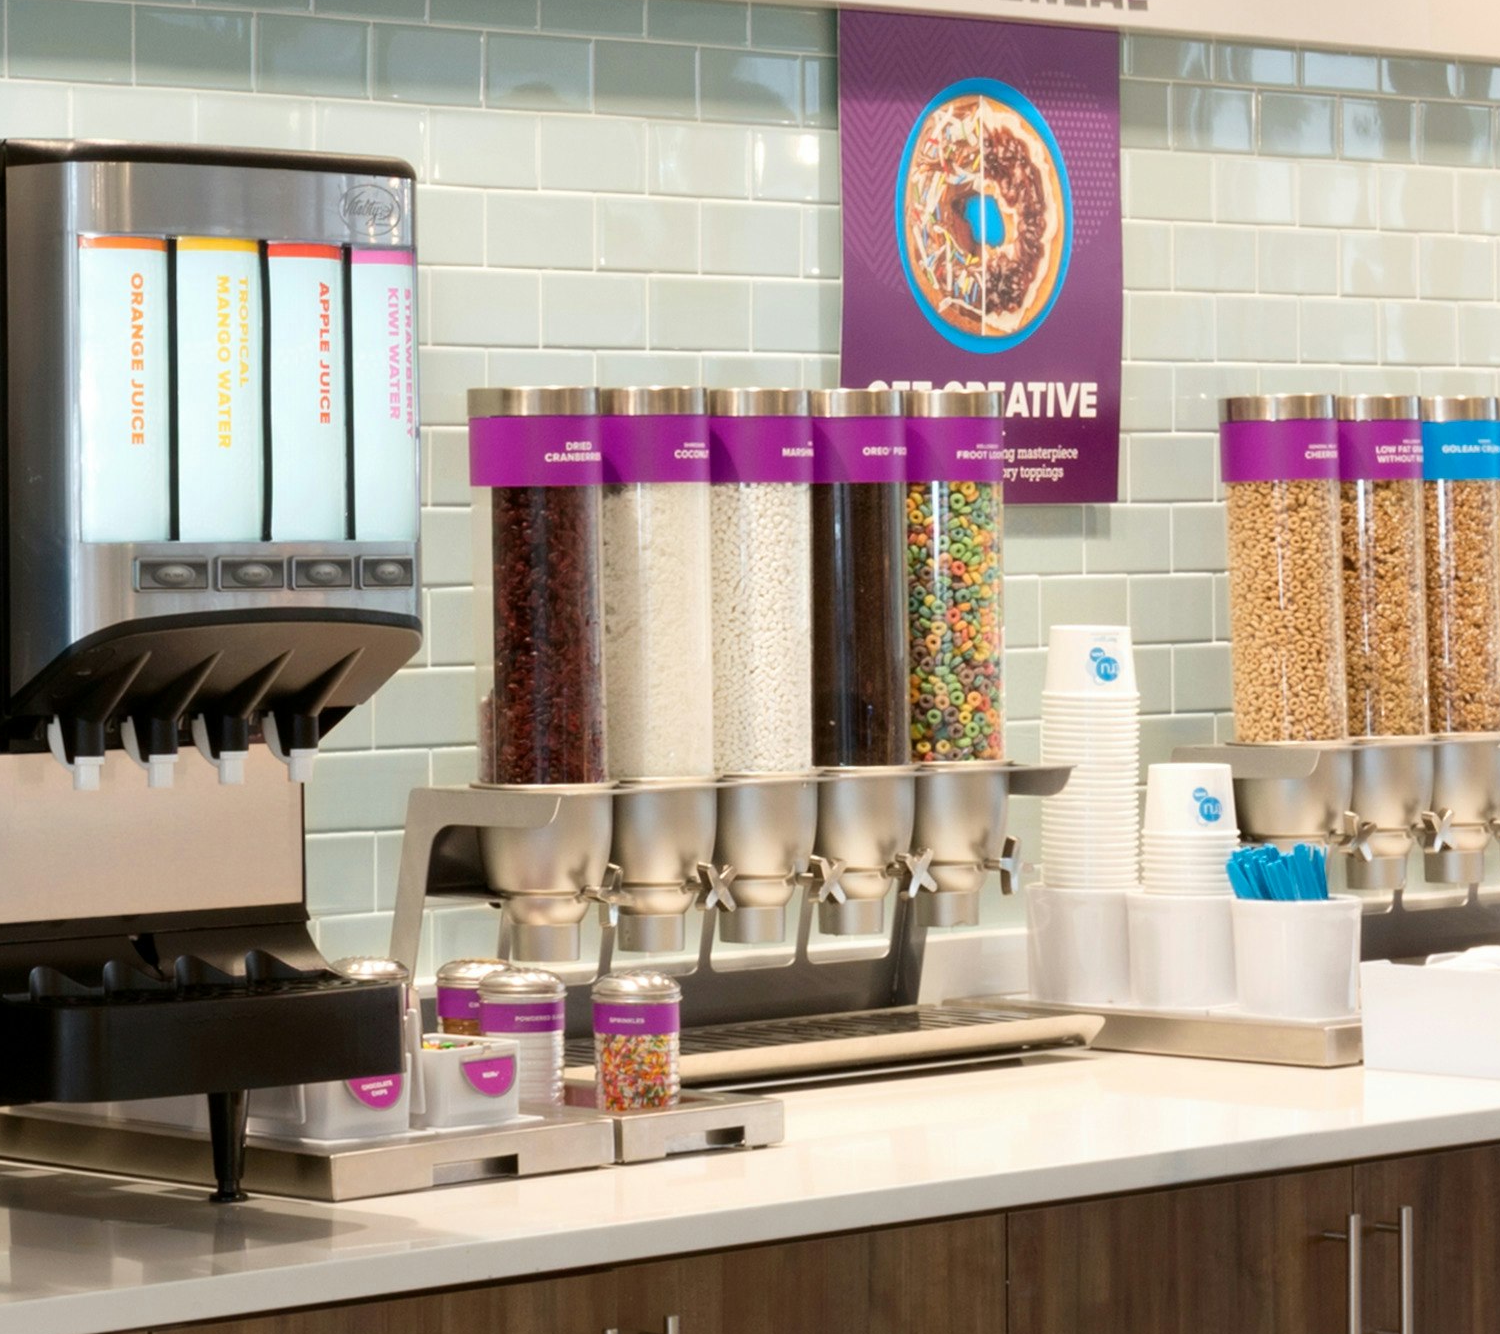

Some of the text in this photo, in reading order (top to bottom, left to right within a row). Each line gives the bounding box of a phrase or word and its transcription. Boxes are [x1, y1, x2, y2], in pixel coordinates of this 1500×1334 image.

[238, 276, 249, 388] TROPICAL
[130, 272, 145, 444] ORANGE JUICE
[216, 275, 232, 448] MANGO WATER
[319, 282, 331, 424] APPLE JUICE
[387, 287, 400, 419] KIWI WATER
[404, 288, 413, 438] STRAWBERRY
[943, 380, 1098, 418] ATIVE
[566, 441, 593, 451] DRIED
[956, 450, 987, 460] FROOT
[1016, 445, 1079, 463] masterpiece
[1375, 445, 1396, 455] LOW
[1377, 454, 1415, 463] WITHOUT
[1019, 464, 1064, 482] toppings
[608, 1016, 645, 1025] SPRINKLES
[360, 1079, 393, 1091] CHOCOLATE
[371, 1088, 388, 1097] CHIPS
